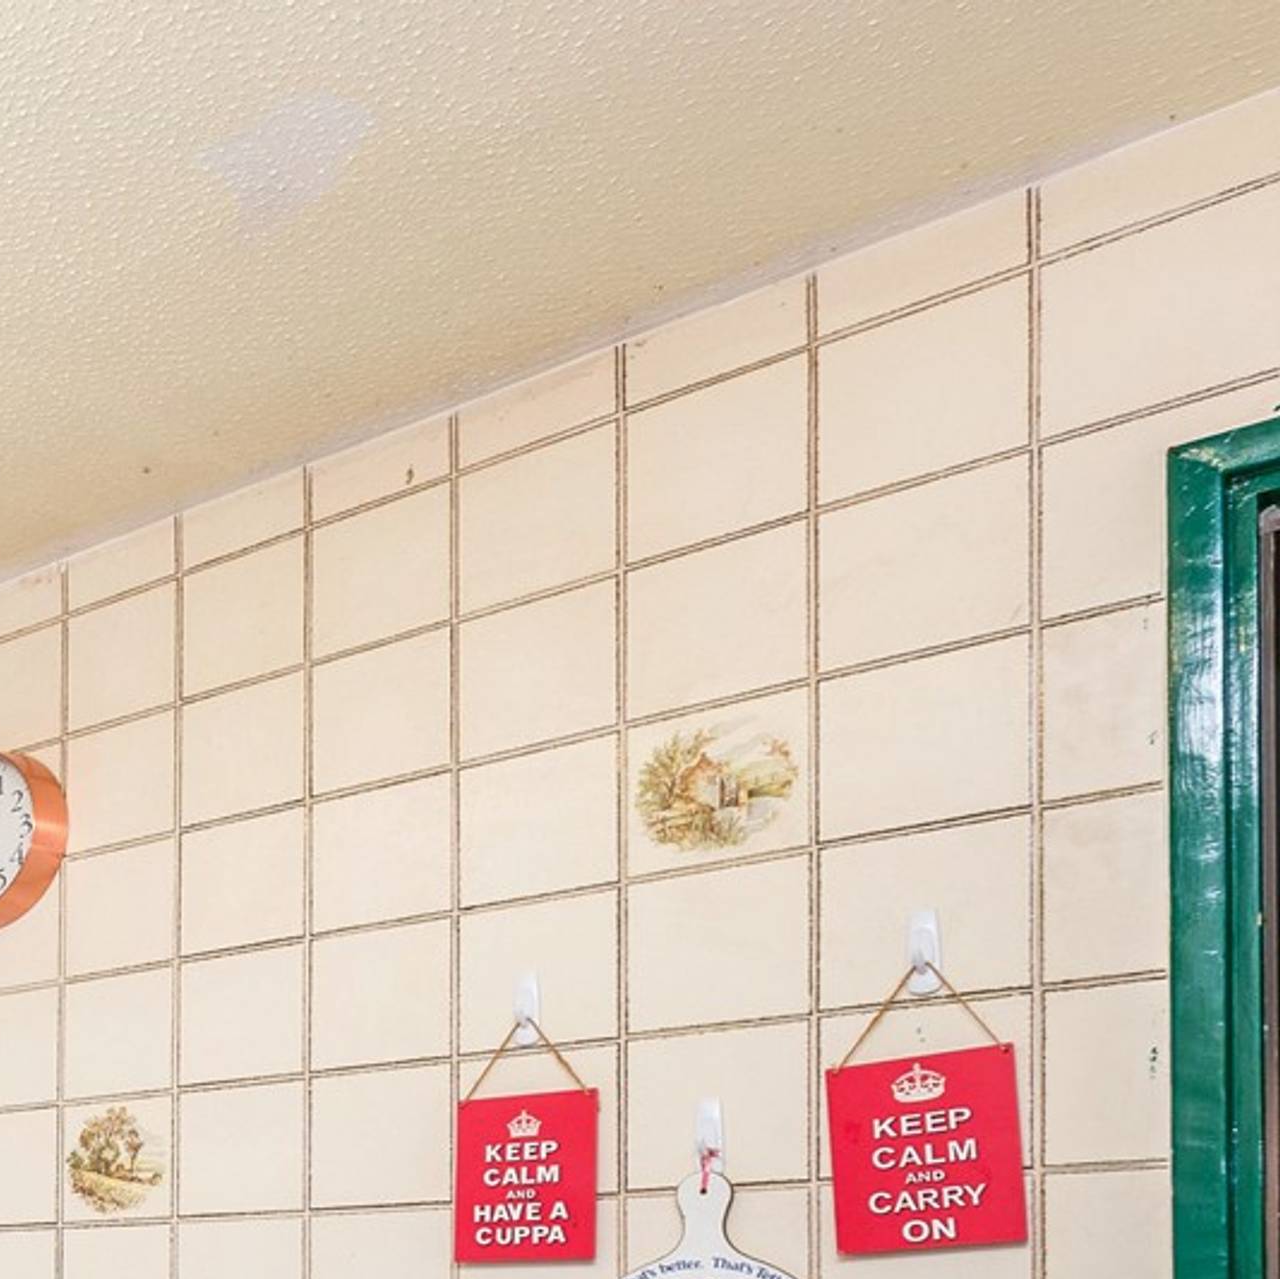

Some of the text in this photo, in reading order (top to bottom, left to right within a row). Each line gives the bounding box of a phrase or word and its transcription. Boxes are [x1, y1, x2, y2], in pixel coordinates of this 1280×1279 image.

[11, 790, 23, 812] 2
[21, 813, 33, 837] 3
[9, 842, 24, 865] 4
[872, 1108, 971, 1139] KEEP
[485, 1140, 558, 1162] KEEP
[872, 1138, 977, 1169] CALM
[484, 1164, 560, 1186] CALM
[905, 1170, 945, 1184] AND
[506, 1189, 536, 1199] AND
[868, 1183, 986, 1214] CARRY
[473, 1200, 569, 1222] HAVE A
[475, 1225, 566, 1245] CUPPA
[902, 1217, 957, 1242] ON
[712, 1257, 753, 1274] That's
